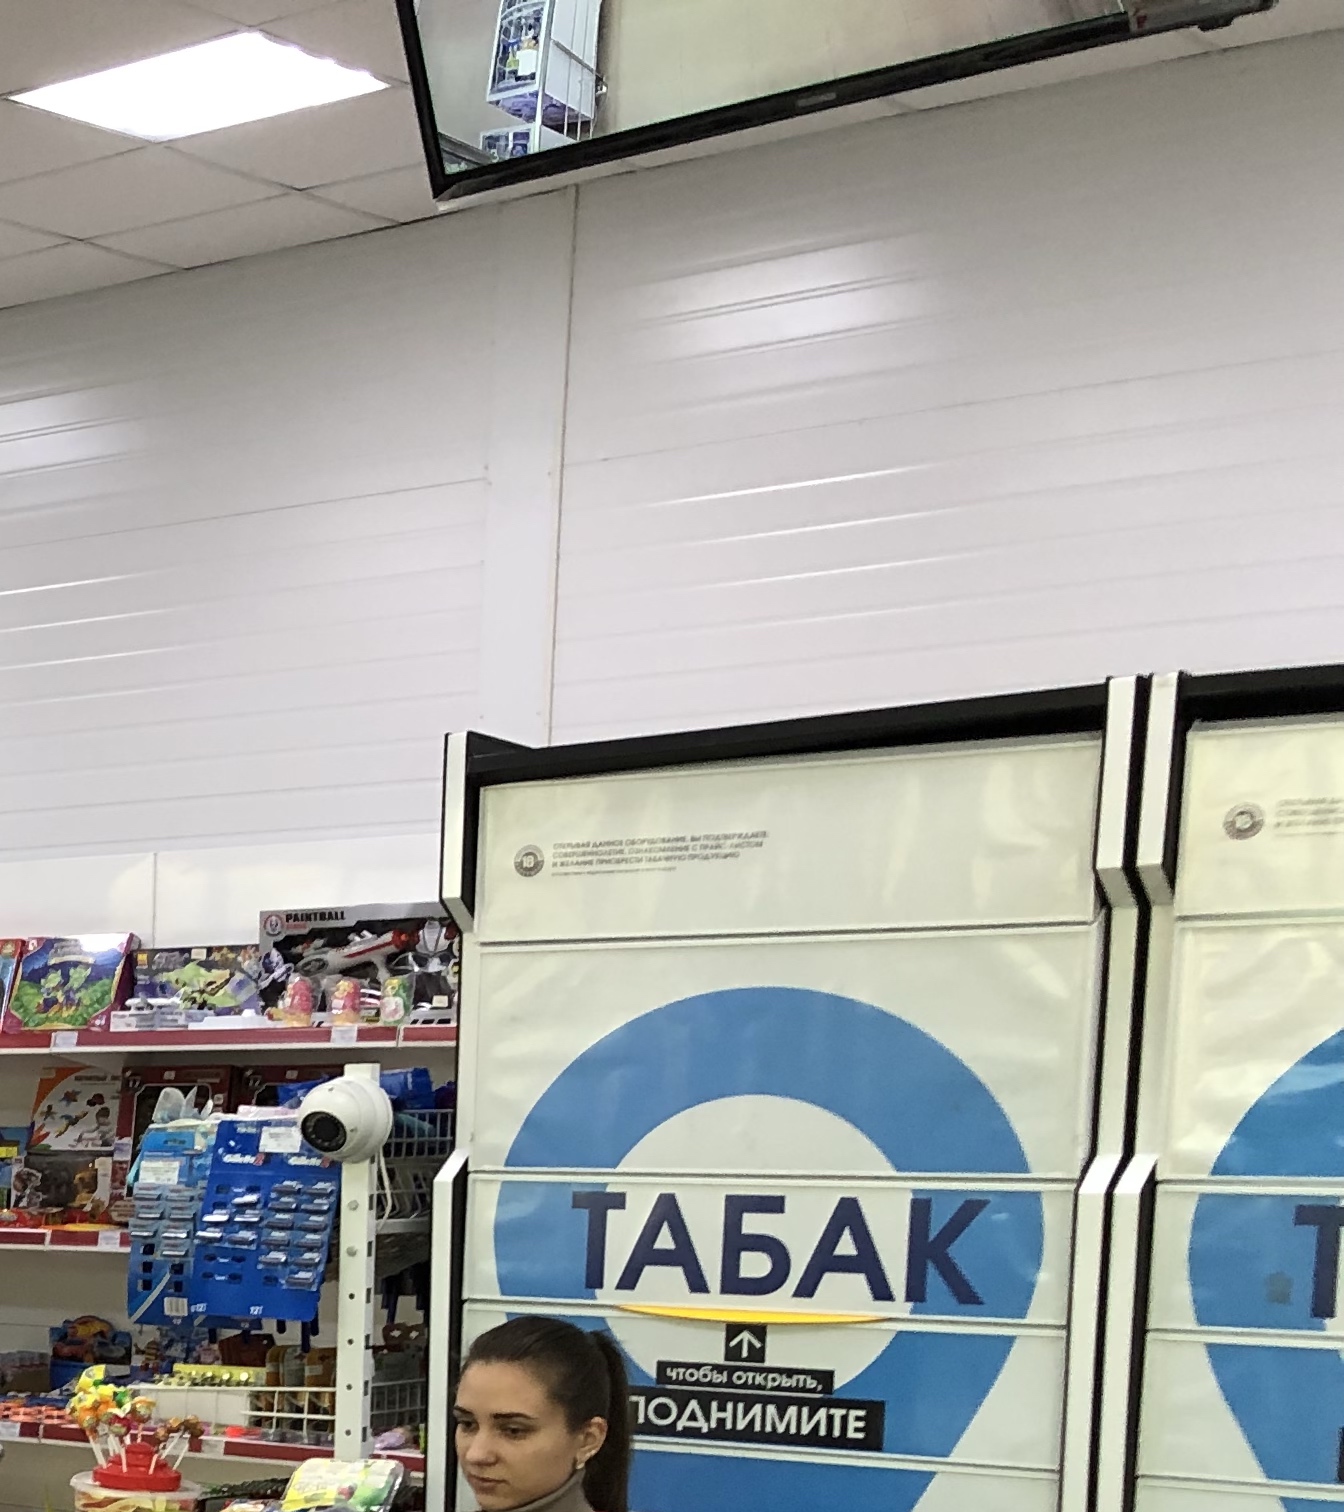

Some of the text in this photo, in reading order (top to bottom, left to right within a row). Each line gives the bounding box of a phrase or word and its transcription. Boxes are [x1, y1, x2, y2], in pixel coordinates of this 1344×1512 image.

[285, 910, 346, 923] PAINTBALL
[572, 1189, 991, 1306] ТАБАК
[666, 1366, 825, 1393] чтобы открыть,
